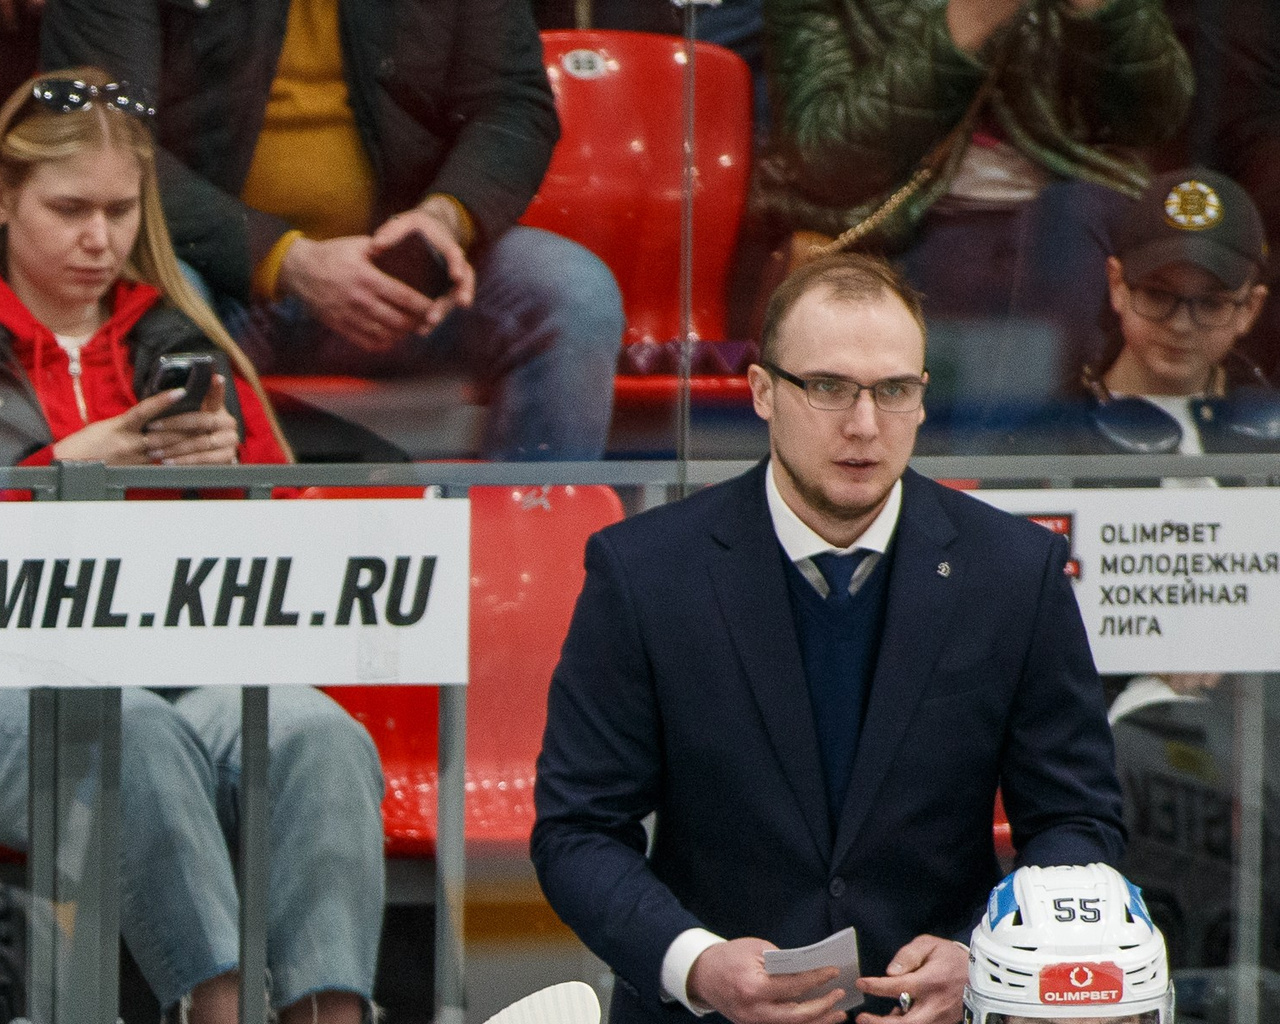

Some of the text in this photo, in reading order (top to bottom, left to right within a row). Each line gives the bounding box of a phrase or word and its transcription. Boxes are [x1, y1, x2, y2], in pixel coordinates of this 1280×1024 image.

[1100, 523, 1220, 543] OLIMPBET
[1100, 554, 1279, 576] МОЛОДЕЖНАЯ
[1099, 578, 1248, 605] ХОККЕЙНАЯ
[1099, 615, 1162, 636] ЛИГА
[1052, 897, 1102, 923] 55
[1044, 989, 1119, 1001] OLIMPBET
